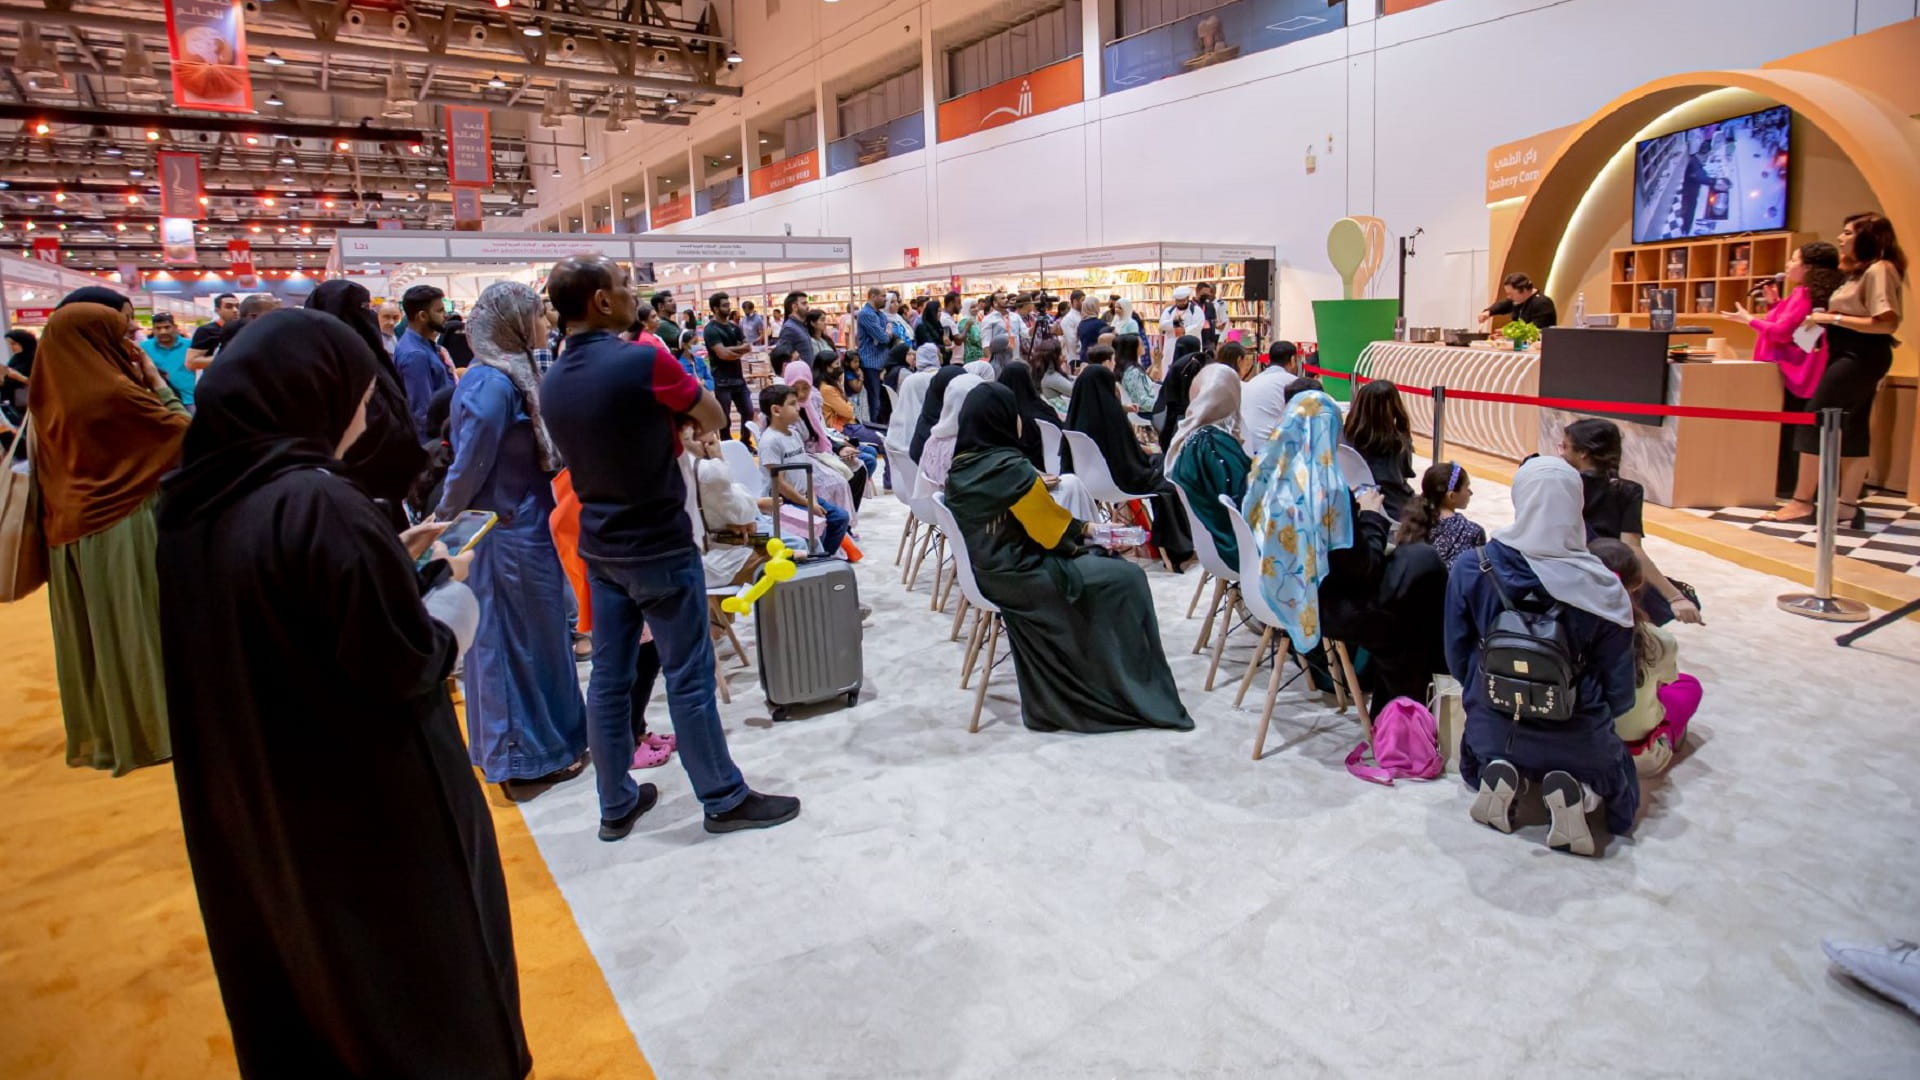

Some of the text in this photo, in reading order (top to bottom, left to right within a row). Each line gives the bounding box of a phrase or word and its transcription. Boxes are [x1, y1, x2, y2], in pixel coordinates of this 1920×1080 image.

[1489, 170, 1540, 191] Cookery Corn
[40, 249, 57, 263] N
[232, 250, 249, 263] M
